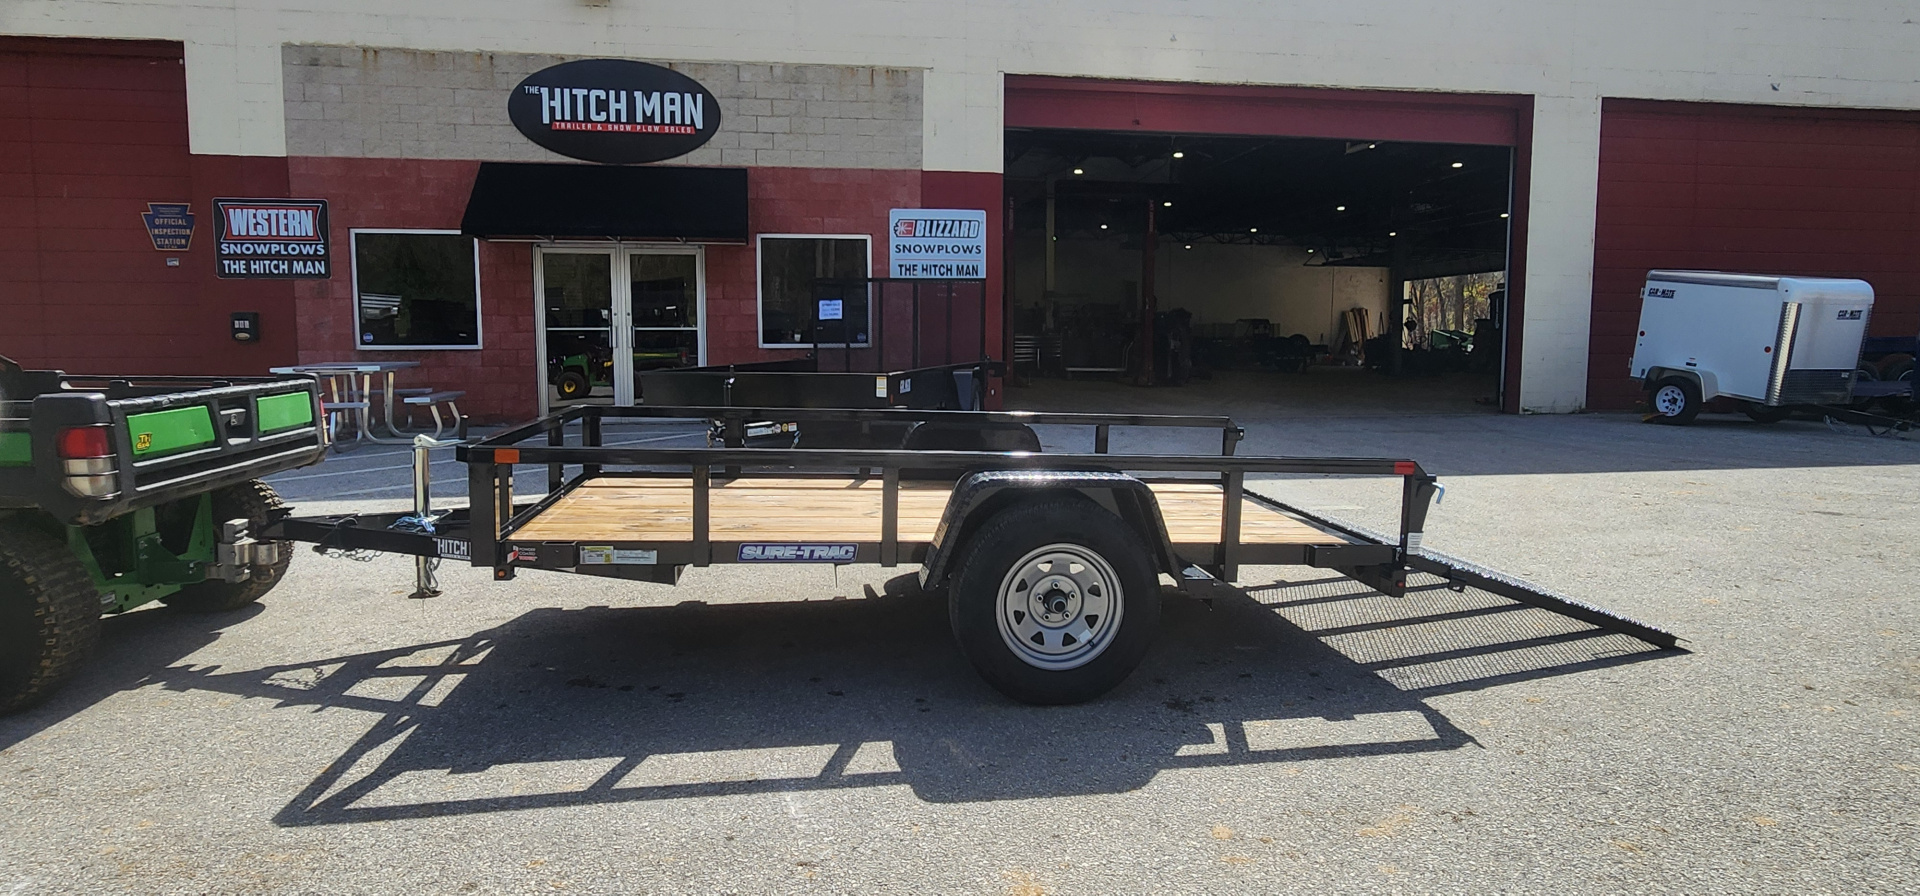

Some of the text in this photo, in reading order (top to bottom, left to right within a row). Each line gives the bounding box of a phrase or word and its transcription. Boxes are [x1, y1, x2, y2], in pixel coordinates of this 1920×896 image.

[524, 86, 703, 129] THE HITCH MAN
[556, 122, 592, 130] TRAILER
[154, 218, 187, 226] OFFICIAL
[228, 209, 314, 237] WESTERN
[151, 228, 191, 236] INSPECTION
[915, 220, 980, 238] BLIZZARD
[220, 243, 325, 255] SNOWPLOWS
[895, 244, 982, 255] SNOWPLOWS
[223, 260, 325, 274] THE HITCH MAN
[898, 264, 979, 277] THE HITCH MAN
[437, 539, 467, 555] HITCH
[742, 546, 855, 560] SURE-TRAC
